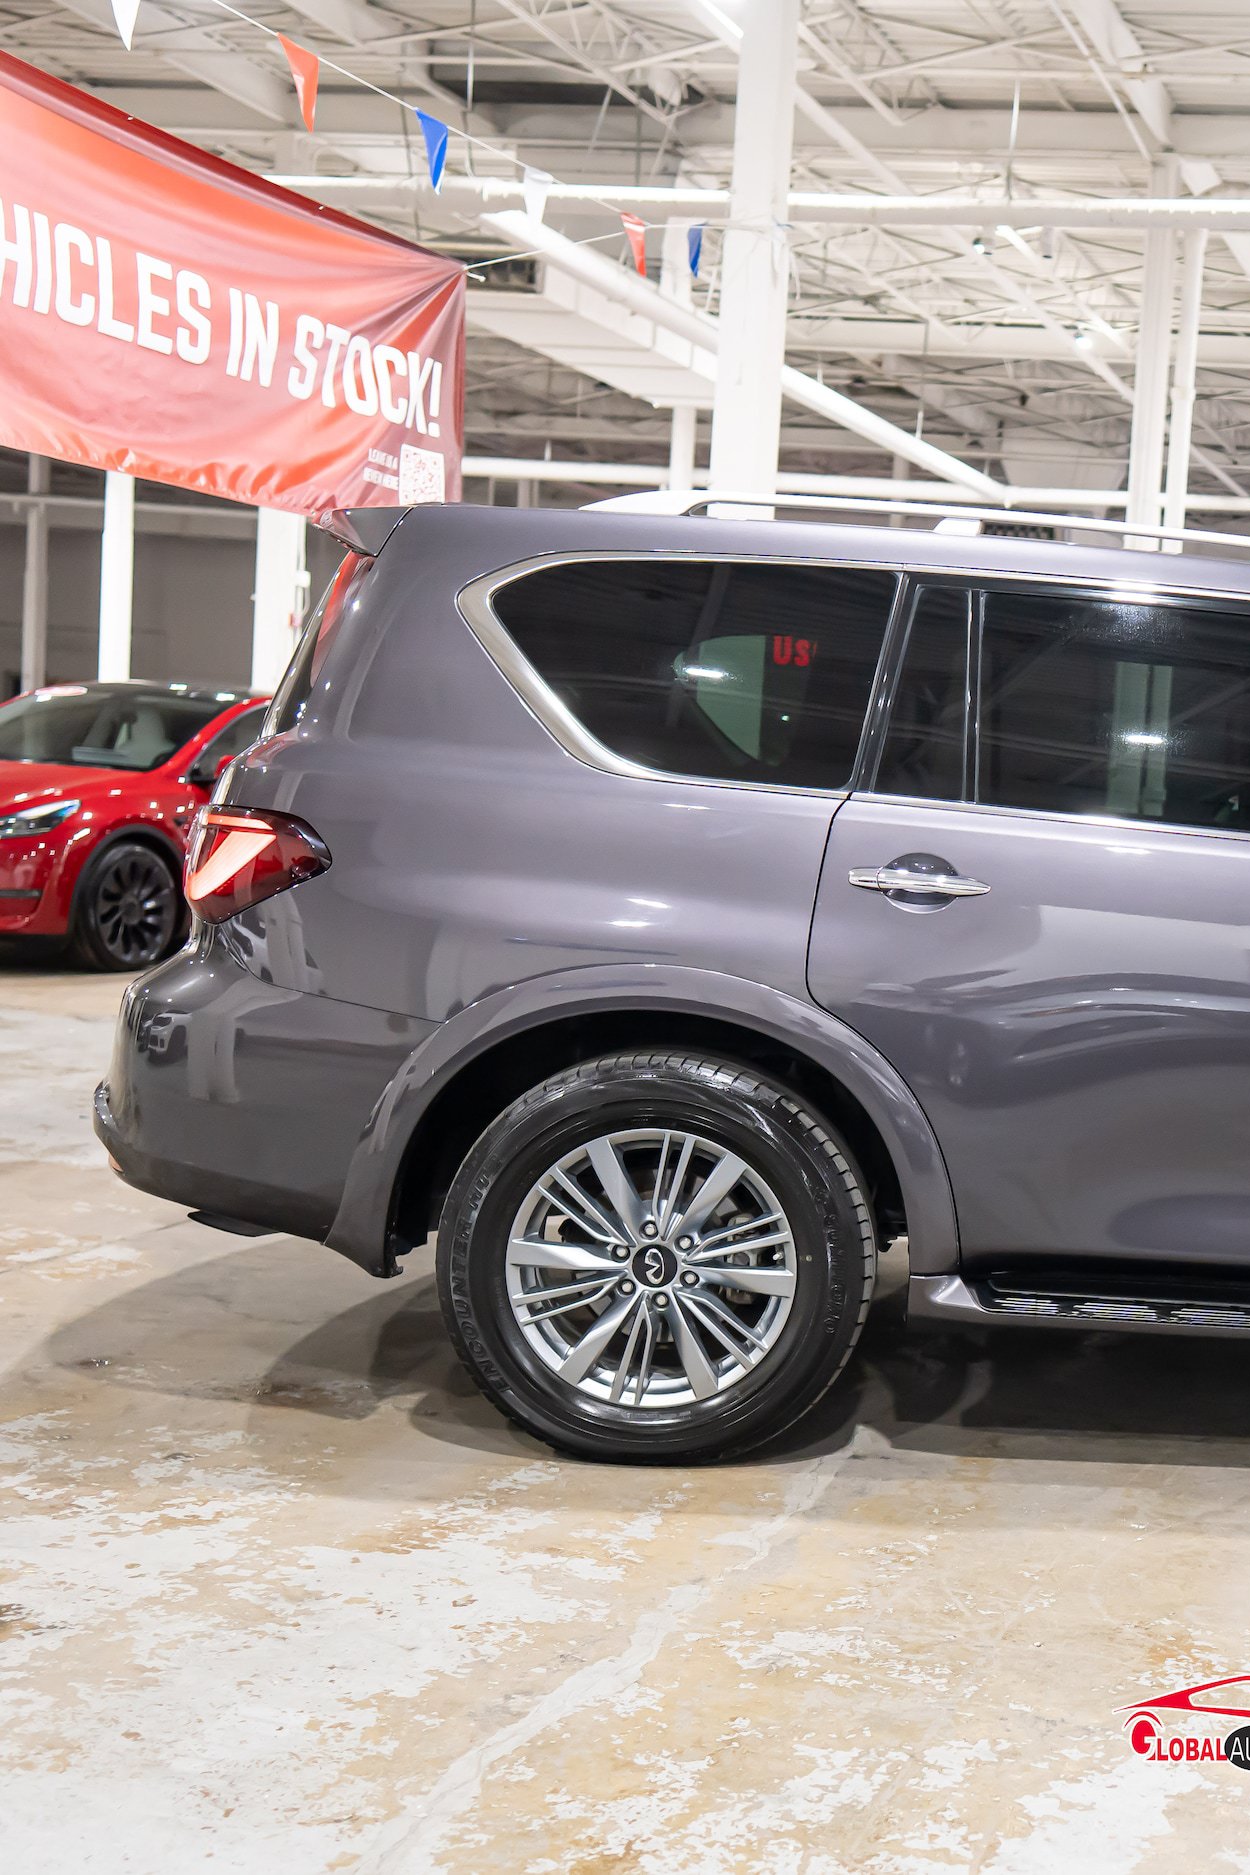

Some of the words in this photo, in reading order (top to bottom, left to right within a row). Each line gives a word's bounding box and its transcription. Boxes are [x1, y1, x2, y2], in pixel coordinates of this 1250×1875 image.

[0, 196, 212, 366] HICLES
[225, 286, 280, 388] IN
[287, 314, 443, 438] STOCK!
